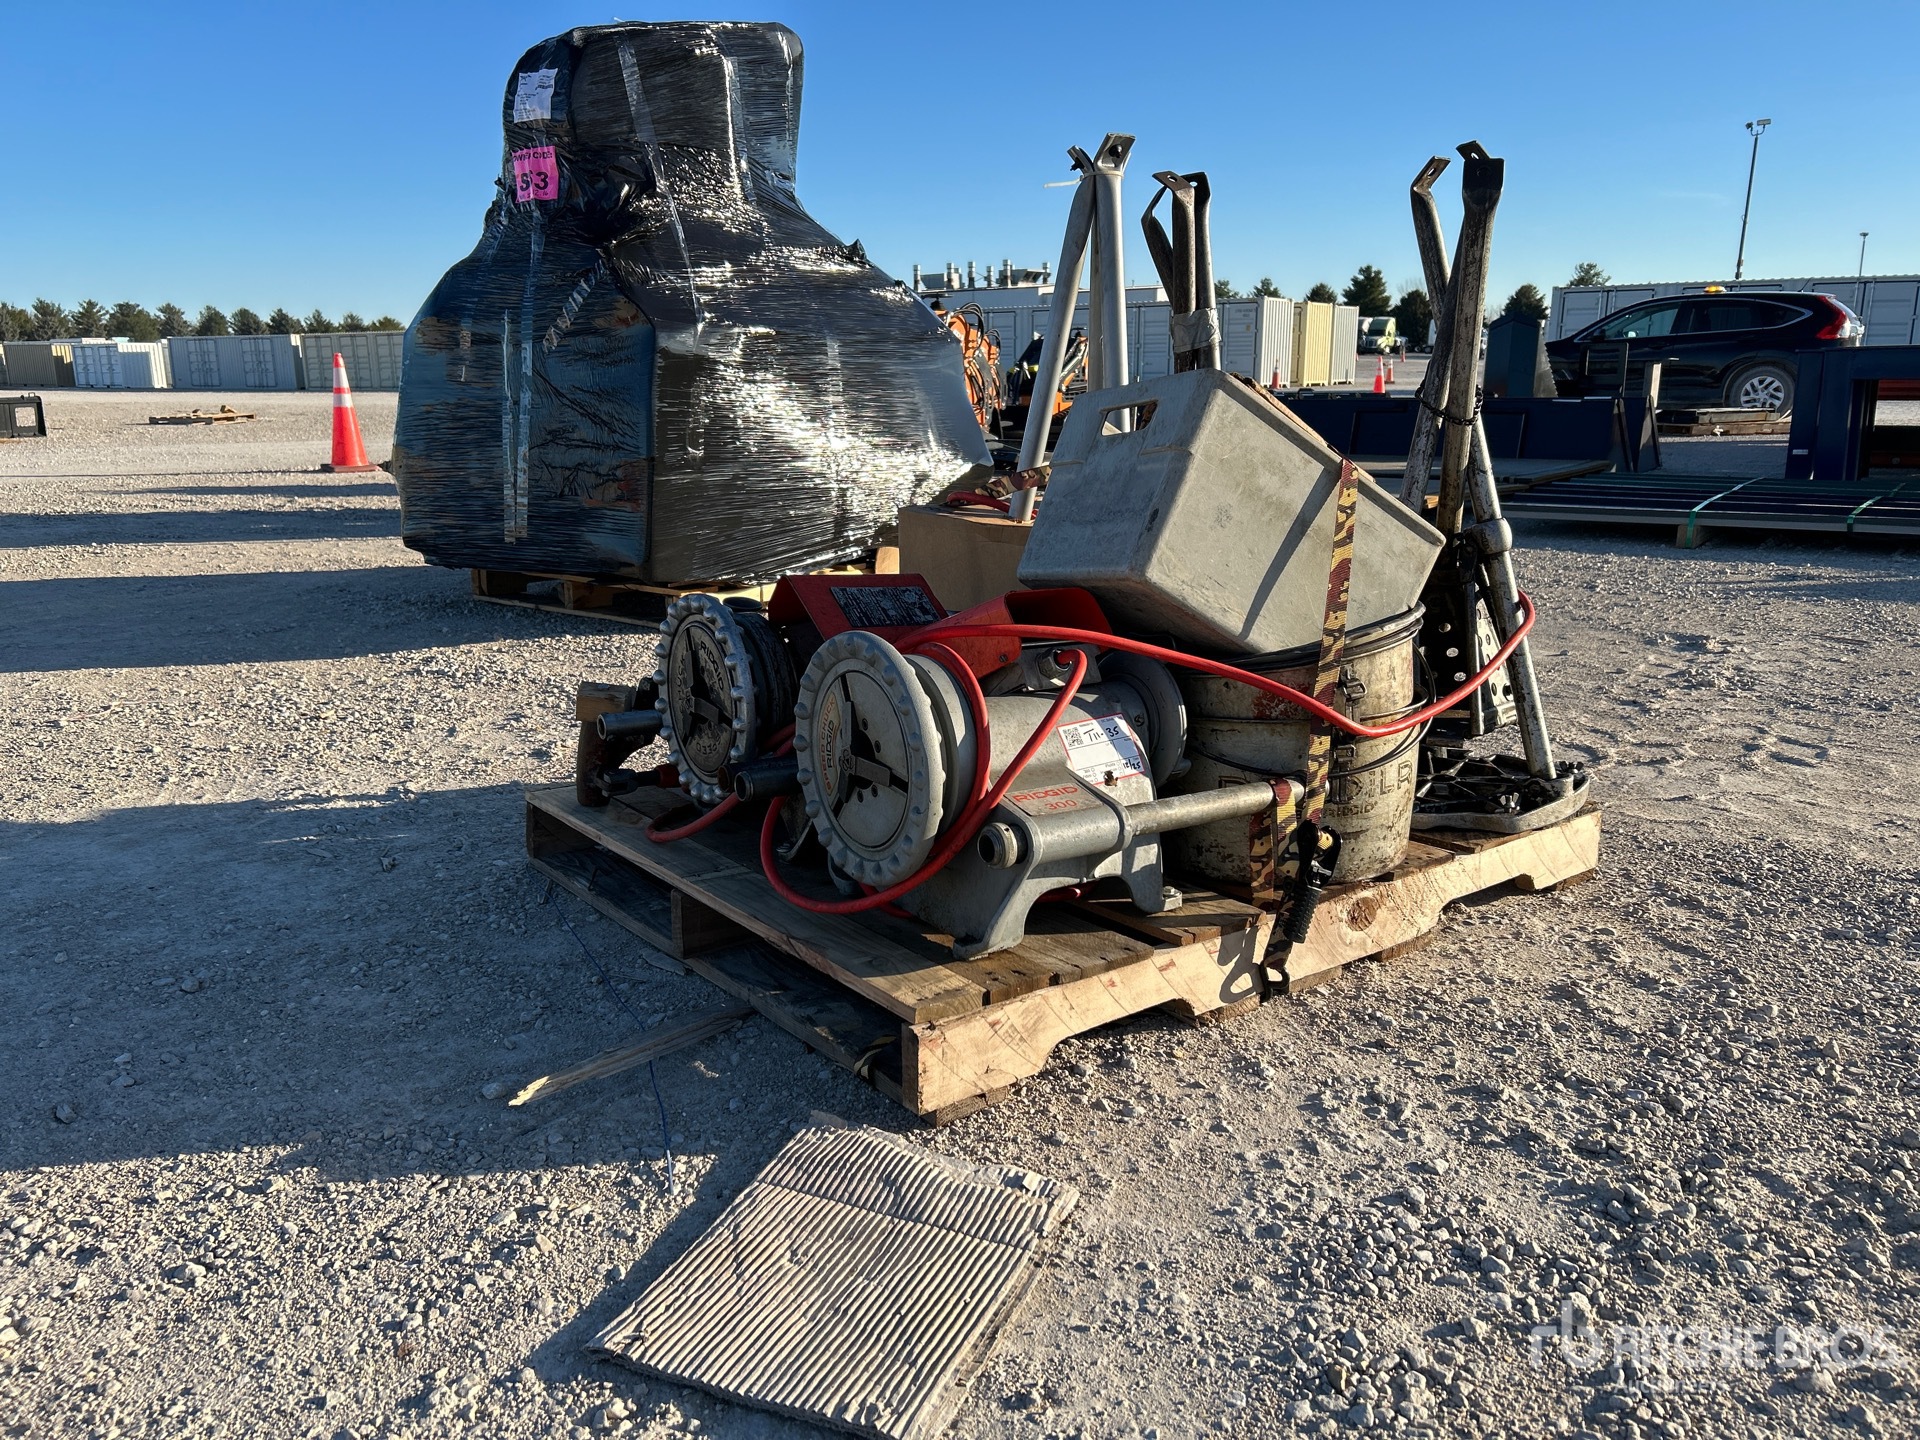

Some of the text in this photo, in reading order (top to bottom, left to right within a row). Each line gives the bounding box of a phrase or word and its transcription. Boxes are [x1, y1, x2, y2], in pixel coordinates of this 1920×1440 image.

[699, 641, 724, 691] RIDGID
[821, 697, 835, 741] CHUCK
[820, 744, 832, 790] SPEED
[825, 720, 835, 769] RIDGID
[1012, 786, 1078, 803] RIDGID
[1044, 799, 1078, 810] 300
